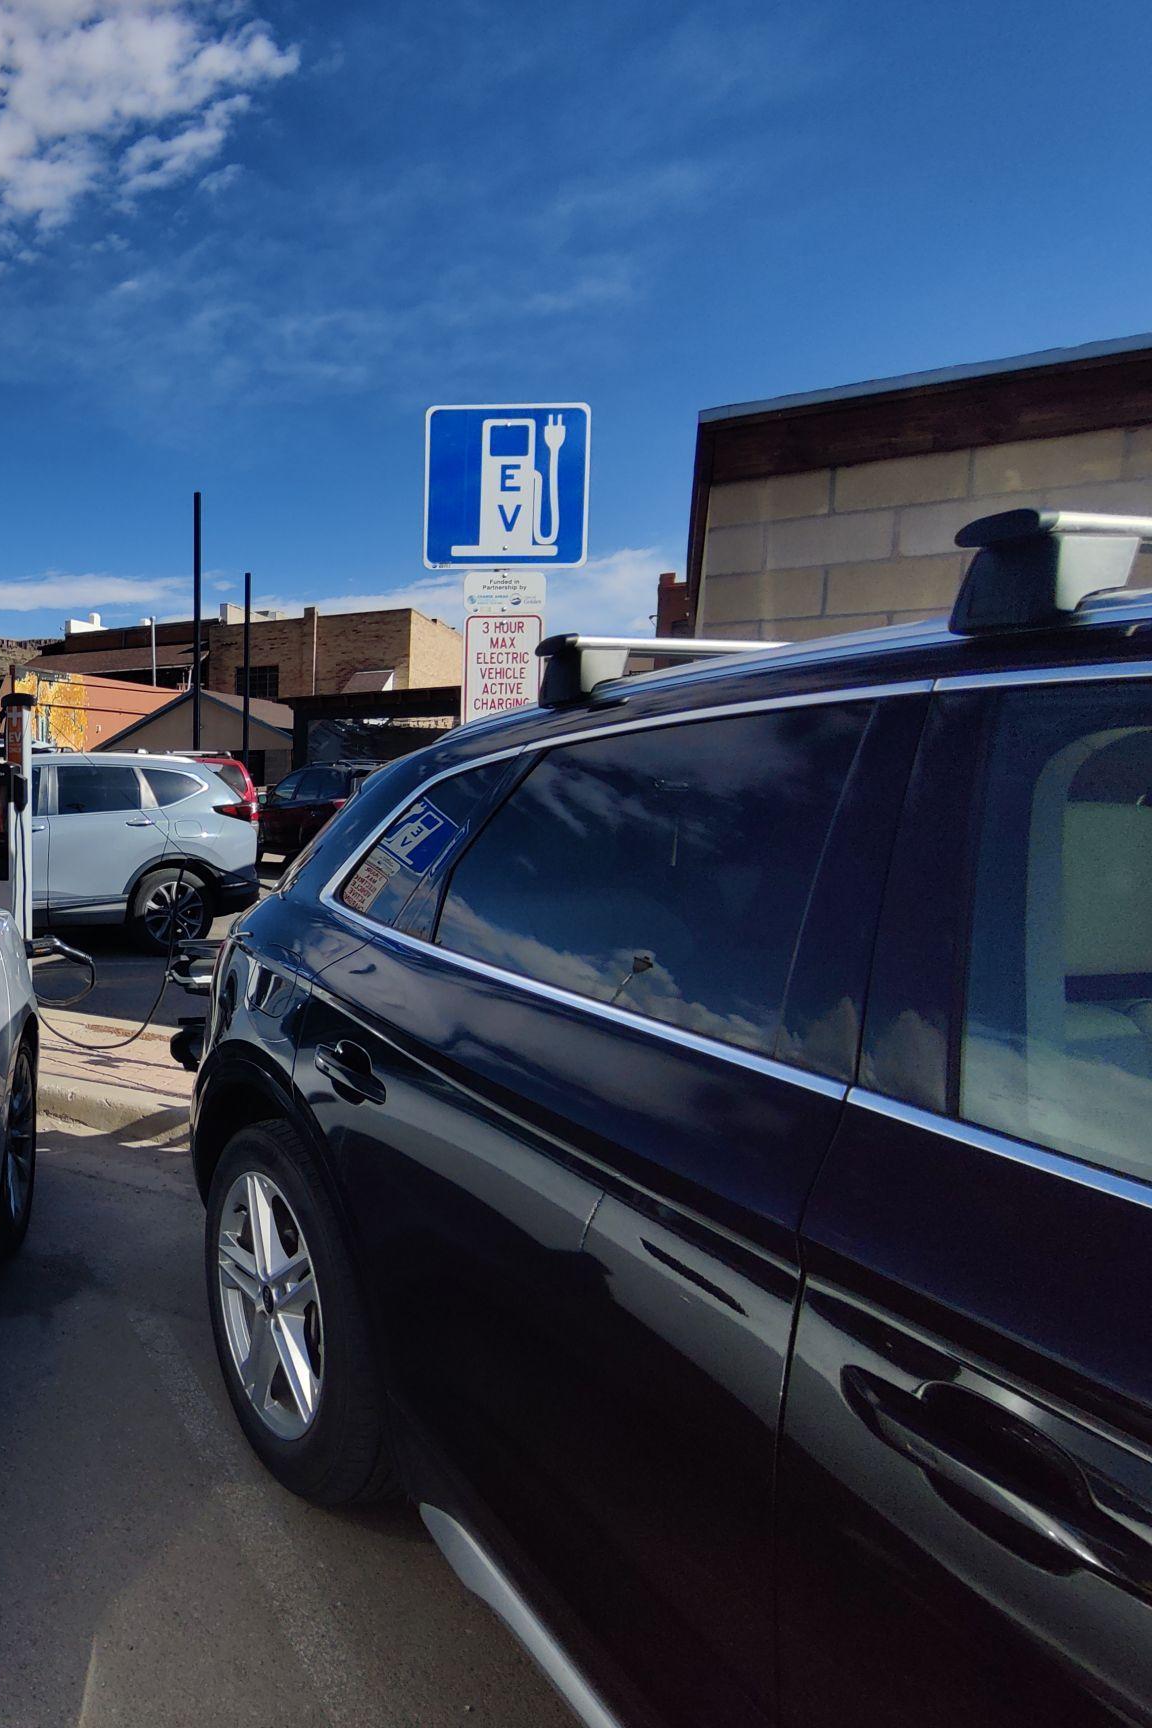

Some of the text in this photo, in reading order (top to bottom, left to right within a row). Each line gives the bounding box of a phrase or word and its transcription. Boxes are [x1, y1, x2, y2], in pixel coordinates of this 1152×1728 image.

[482, 621, 525, 634] 3 HOUR
[490, 637, 516, 649] MAX
[476, 652, 530, 664] ELECTRIC
[479, 667, 526, 679] VEHICLE
[482, 682, 523, 694] ACTIVE
[9, 732, 21, 742] EV
